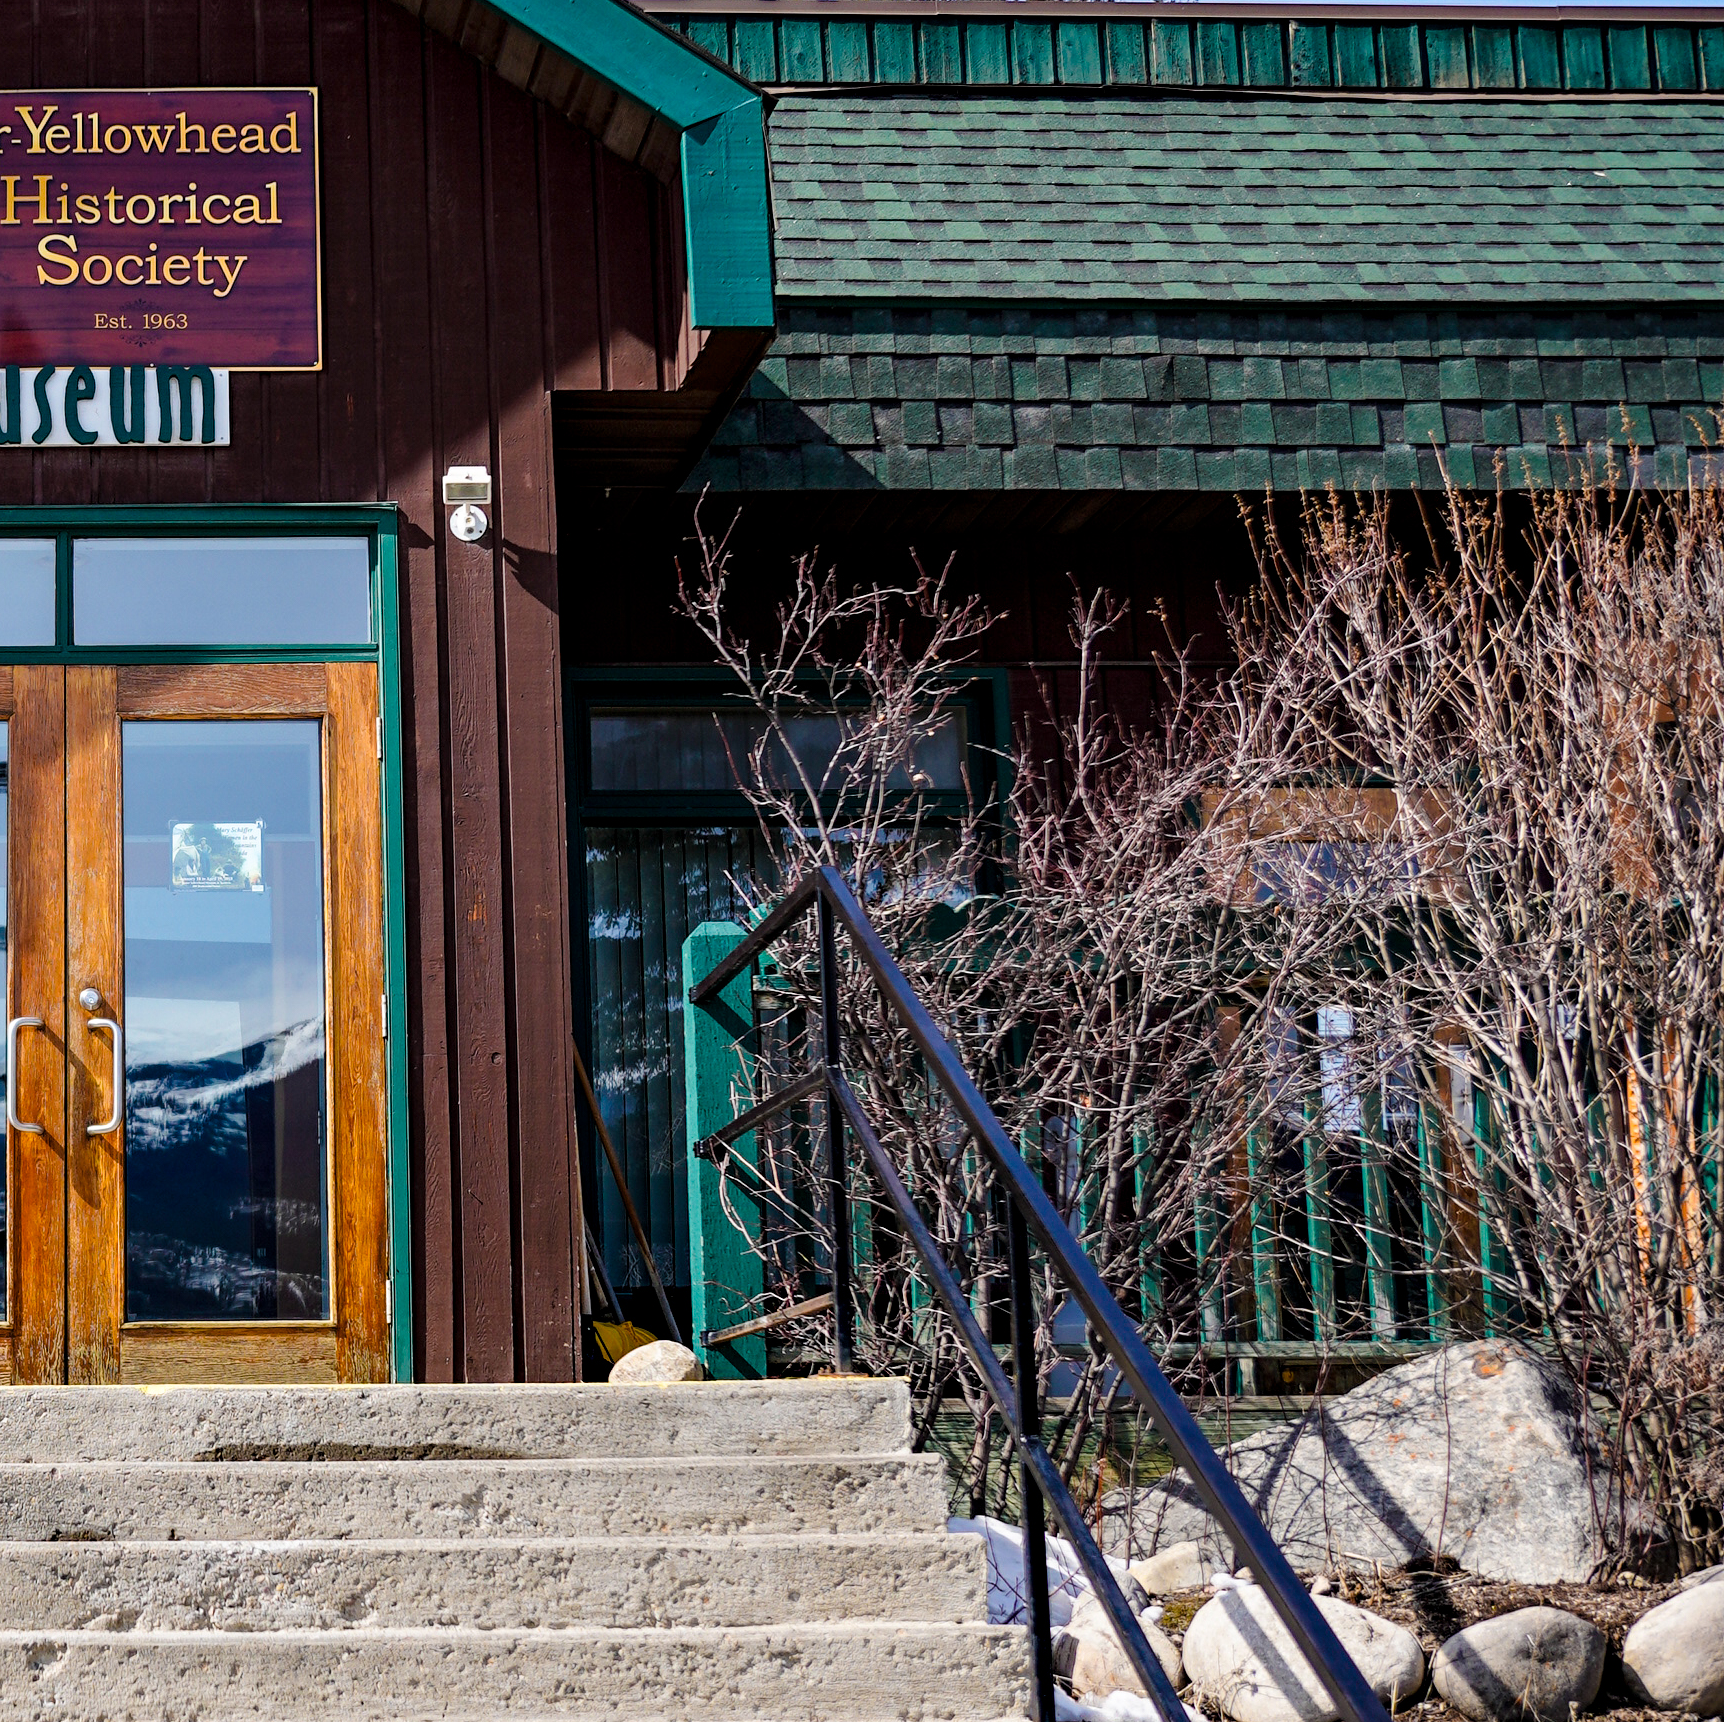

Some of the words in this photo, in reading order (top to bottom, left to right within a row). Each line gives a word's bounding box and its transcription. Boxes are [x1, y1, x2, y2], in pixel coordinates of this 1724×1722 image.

[0, 175, 283, 226] Historical
[36, 234, 248, 297] Society
[93, 313, 133, 330] Est.
[142, 313, 189, 330] 1963
